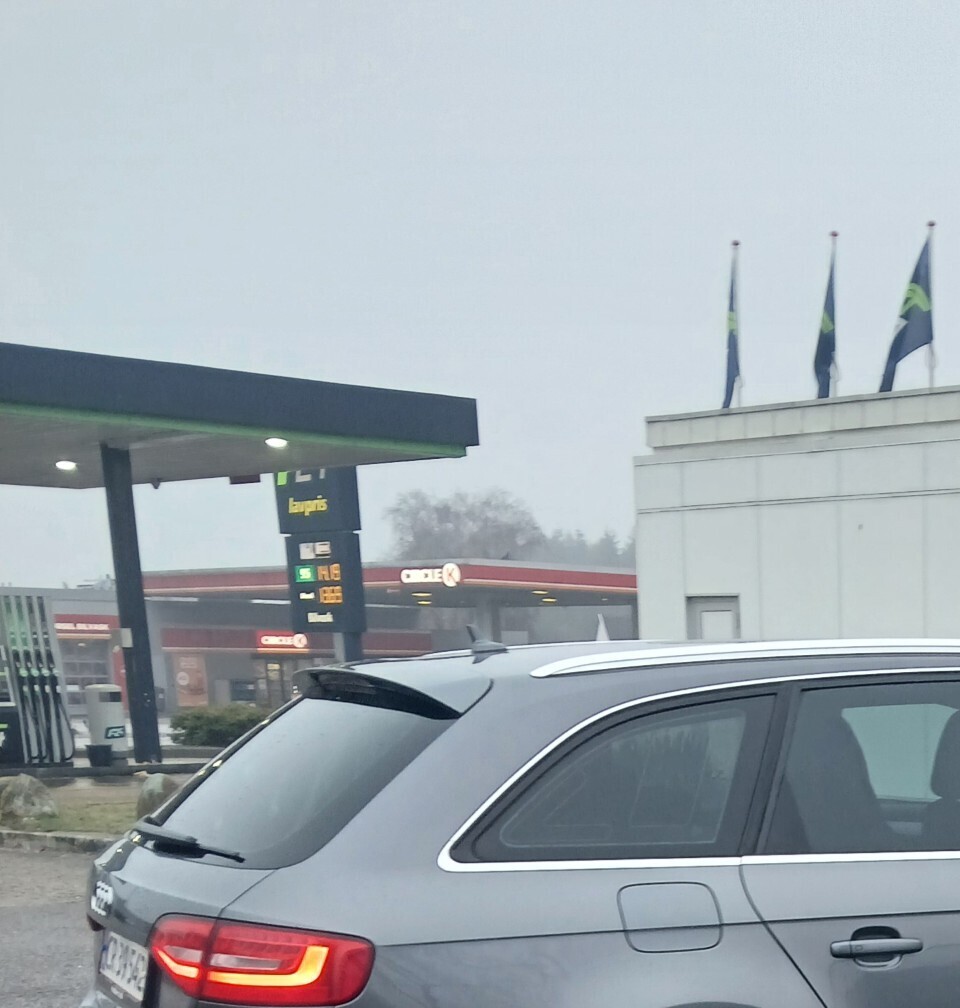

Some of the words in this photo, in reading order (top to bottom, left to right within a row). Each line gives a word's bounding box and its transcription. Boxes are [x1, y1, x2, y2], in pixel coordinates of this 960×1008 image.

[401, 569, 442, 583] CIRCLE
[443, 563, 461, 587] K
[261, 636, 293, 645] CIRCLE
